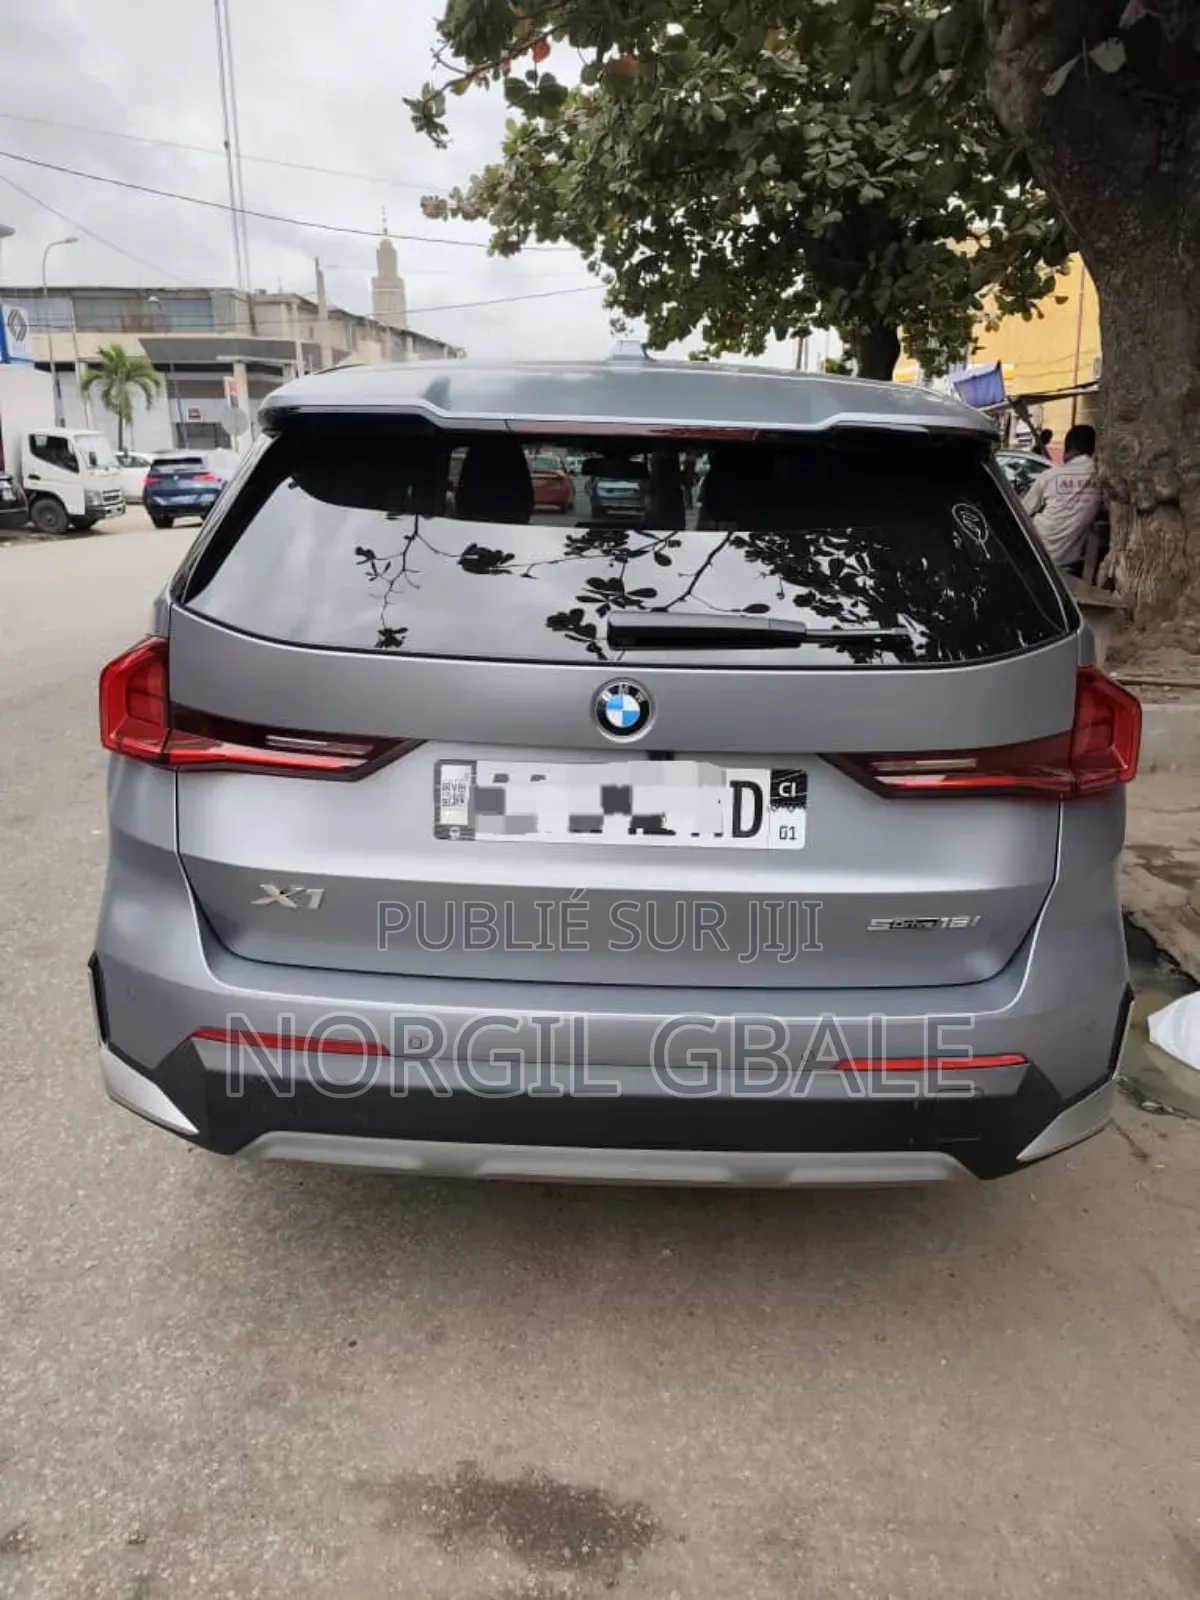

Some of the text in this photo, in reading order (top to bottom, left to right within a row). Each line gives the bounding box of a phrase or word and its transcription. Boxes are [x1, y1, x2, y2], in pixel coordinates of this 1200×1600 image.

[778, 782, 796, 797] CI
[779, 825, 797, 840] 01
[250, 884, 325, 910] X1
